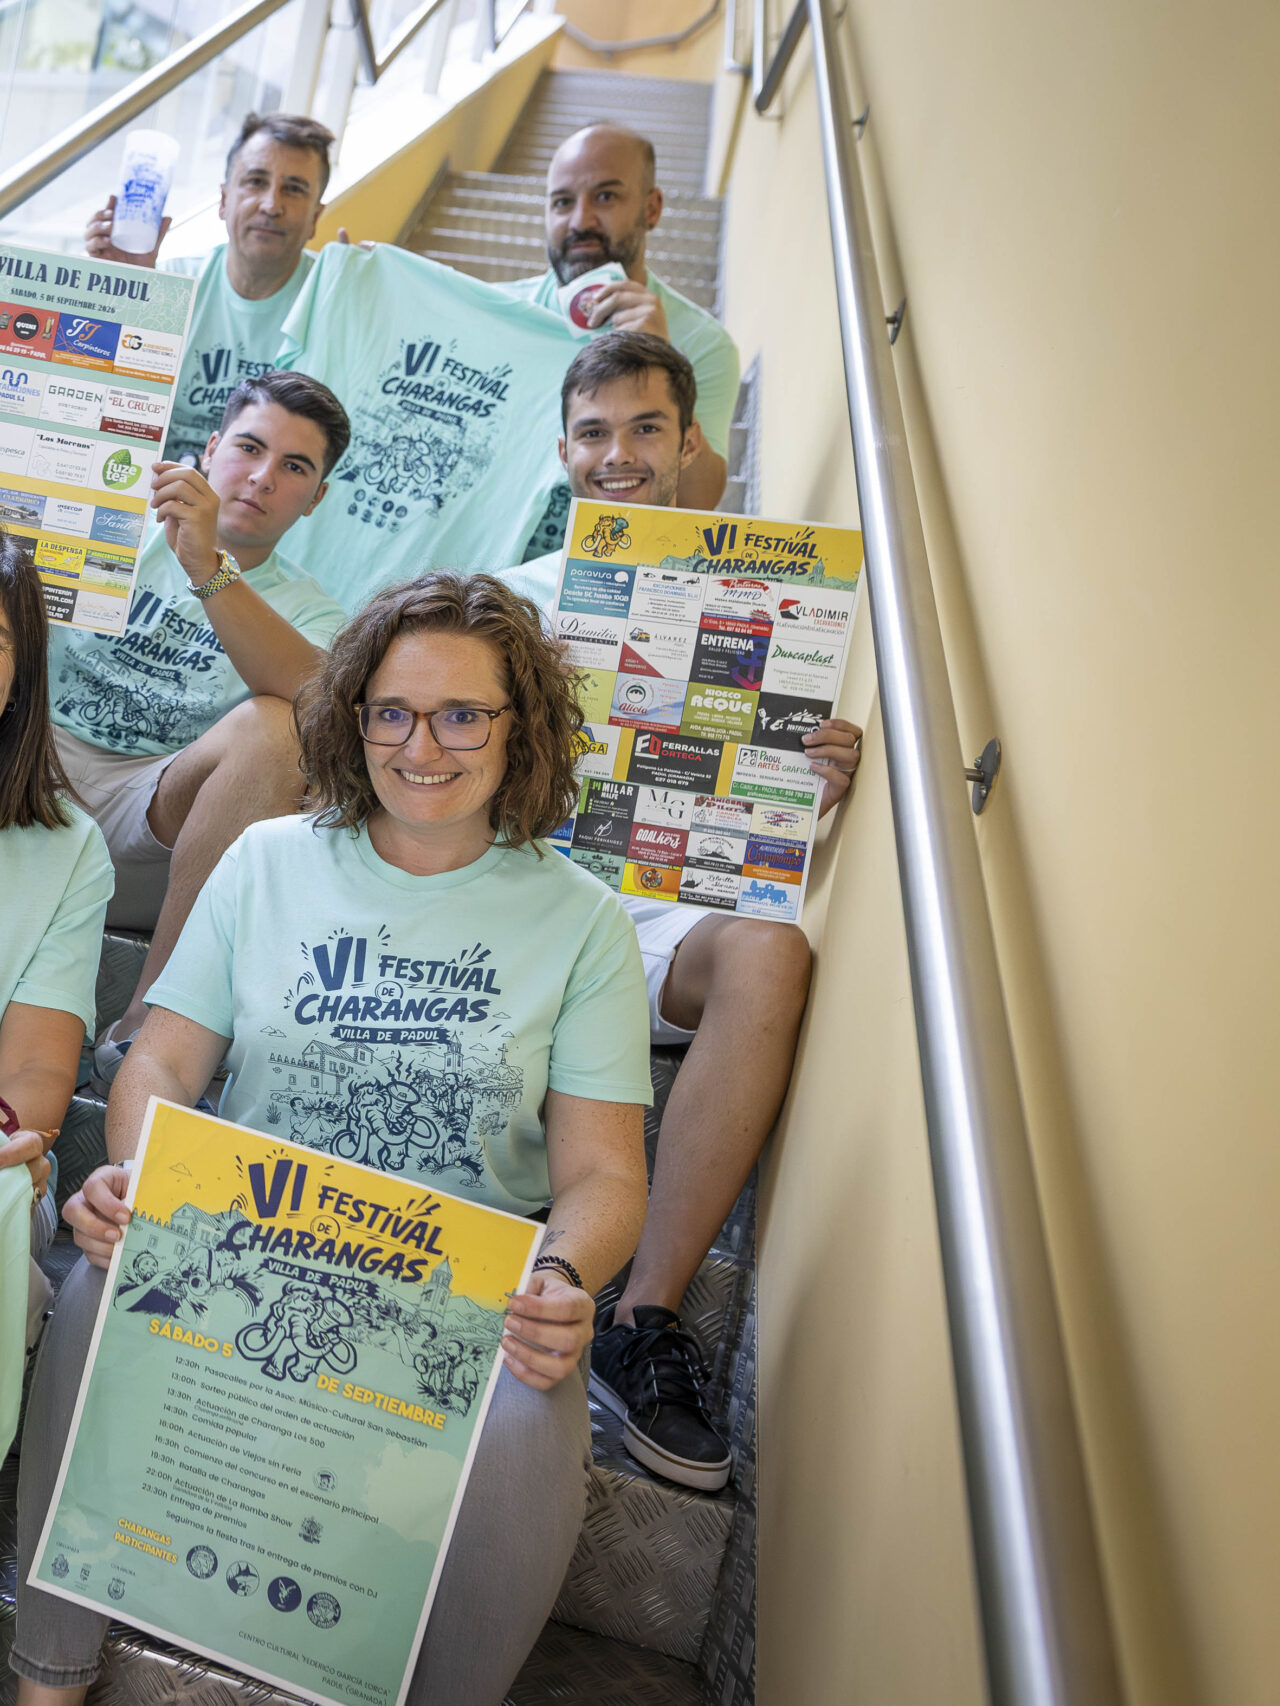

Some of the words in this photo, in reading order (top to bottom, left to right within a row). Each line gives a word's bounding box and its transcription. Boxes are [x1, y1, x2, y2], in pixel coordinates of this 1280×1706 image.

[55, 267, 81, 289] DE
[87, 272, 150, 302] PADUL
[57, 296, 96, 310] SEPTIEMBRE
[97, 304, 116, 314] 2026
[73, 339, 111, 357] Carpinteros
[202, 348, 231, 385] VI
[404, 341, 442, 377] VI
[441, 356, 511, 402] FESTIVAL
[48, 384, 103, 402] GARDEN
[381, 376, 498, 418] CHARANGAS
[106, 470, 128, 484] tea
[107, 459, 138, 476] fuze
[702, 523, 738, 556] VI
[744, 532, 819, 559] FESTIVAL
[745, 551, 754, 560] DE
[692, 558, 811, 576] CHARANGAS
[795, 605, 848, 621] VLADIMIR
[701, 634, 754, 652] ENTRENA
[771, 644, 834, 664] Durcaplast
[117, 652, 135, 667] VILLA
[136, 662, 148, 672] DE
[150, 667, 177, 681] PADUL
[618, 702, 648, 714] Alicia
[705, 688, 742, 699] KIOSCO
[661, 749, 702, 762] ORTEGA
[662, 741, 720, 756] FERRALLAS
[758, 762, 780, 772] ARTES
[602, 782, 634, 797] MILAR
[312, 936, 368, 992] VI
[378, 954, 502, 996] FESTIVAL
[381, 986, 395, 998] DE
[294, 993, 493, 1026] CHARANGAS
[338, 1028, 370, 1040] VILLA
[376, 1030, 393, 1042] DE
[400, 1028, 440, 1042] PADUL
[248, 1159, 309, 1219] VI
[318, 1184, 444, 1256] FESTIVAL
[318, 1222, 331, 1236] DE
[219, 1220, 430, 1285] CHARANGAS
[268, 1260, 304, 1280] VILLA
[306, 1270, 324, 1284] DE
[330, 1274, 368, 1294] PADUL
[148, 1316, 219, 1354] SÁBADO
[222, 1340, 234, 1358] 5
[171, 1372, 197, 1386] 13:00h
[200, 1382, 227, 1397] Sorteo
[227, 1392, 258, 1408] público
[260, 1402, 274, 1412] del
[274, 1407, 300, 1422] orden
[300, 1416, 312, 1426] de
[312, 1421, 356, 1442] actuación
[176, 1356, 200, 1370] 12:30h
[204, 1365, 248, 1386] Pasacalles
[249, 1382, 264, 1392] por
[265, 1386, 274, 1396] la
[366, 1421, 384, 1434] San
[317, 1374, 340, 1393] DE
[342, 1382, 447, 1430] SEPTIEMBRE
[162, 1403, 188, 1418] 14:30h
[192, 1413, 224, 1431] Comida
[224, 1424, 258, 1442] popular
[167, 1388, 192, 1402] 13:30h
[196, 1398, 237, 1418] Actuación
[238, 1411, 250, 1422] de
[250, 1416, 292, 1438] Charanga
[293, 1432, 307, 1444] Los
[309, 1436, 326, 1449] 500
[187, 1430, 229, 1450] Actuación
[230, 1444, 241, 1454] de
[242, 1449, 266, 1464] Viejos
[268, 1459, 280, 1469] sin
[281, 1464, 302, 1477] Feria
[150, 1450, 176, 1466] 19:30h
[179, 1461, 207, 1478] Batalla
[208, 1472, 220, 1482] de
[220, 1477, 266, 1500] Charangas
[183, 1445, 224, 1466] Comienzo
[224, 1460, 238, 1471] del
[240, 1466, 277, 1486] concurso
[278, 1480, 289, 1490] en
[290, 1485, 298, 1494] el
[300, 1490, 340, 1510] escenario
[341, 1504, 380, 1524] principal
[141, 1482, 168, 1499] 23:30h
[170, 1494, 201, 1512] Entrega
[202, 1506, 213, 1516] de
[214, 1512, 248, 1530] premios
[146, 1466, 173, 1482] 22:00h
[174, 1478, 215, 1498] Actuación
[216, 1493, 228, 1504] de
[228, 1498, 238, 1508] La
[240, 1502, 269, 1520] Bomba
[270, 1514, 293, 1528] Show
[114, 1532, 178, 1564] PARTICIPANTES
[118, 1518, 172, 1546] CHARANGAS
[166, 1510, 204, 1531] Seguimos
[206, 1526, 214, 1535] la
[216, 1529, 238, 1544] fiesta
[239, 1539, 256, 1552] tras
[257, 1545, 266, 1555] la
[266, 1550, 300, 1568] entrega
[300, 1563, 312, 1574] de
[312, 1568, 348, 1588] premios
[349, 1582, 366, 1594] con
[366, 1588, 378, 1599] DJ
[238, 1630, 266, 1648] CENTRO
[266, 1642, 300, 1662] CULTURAL
[322, 1676, 344, 1692] PADUL
[345, 1685, 388, 1706] (GRANADA)
